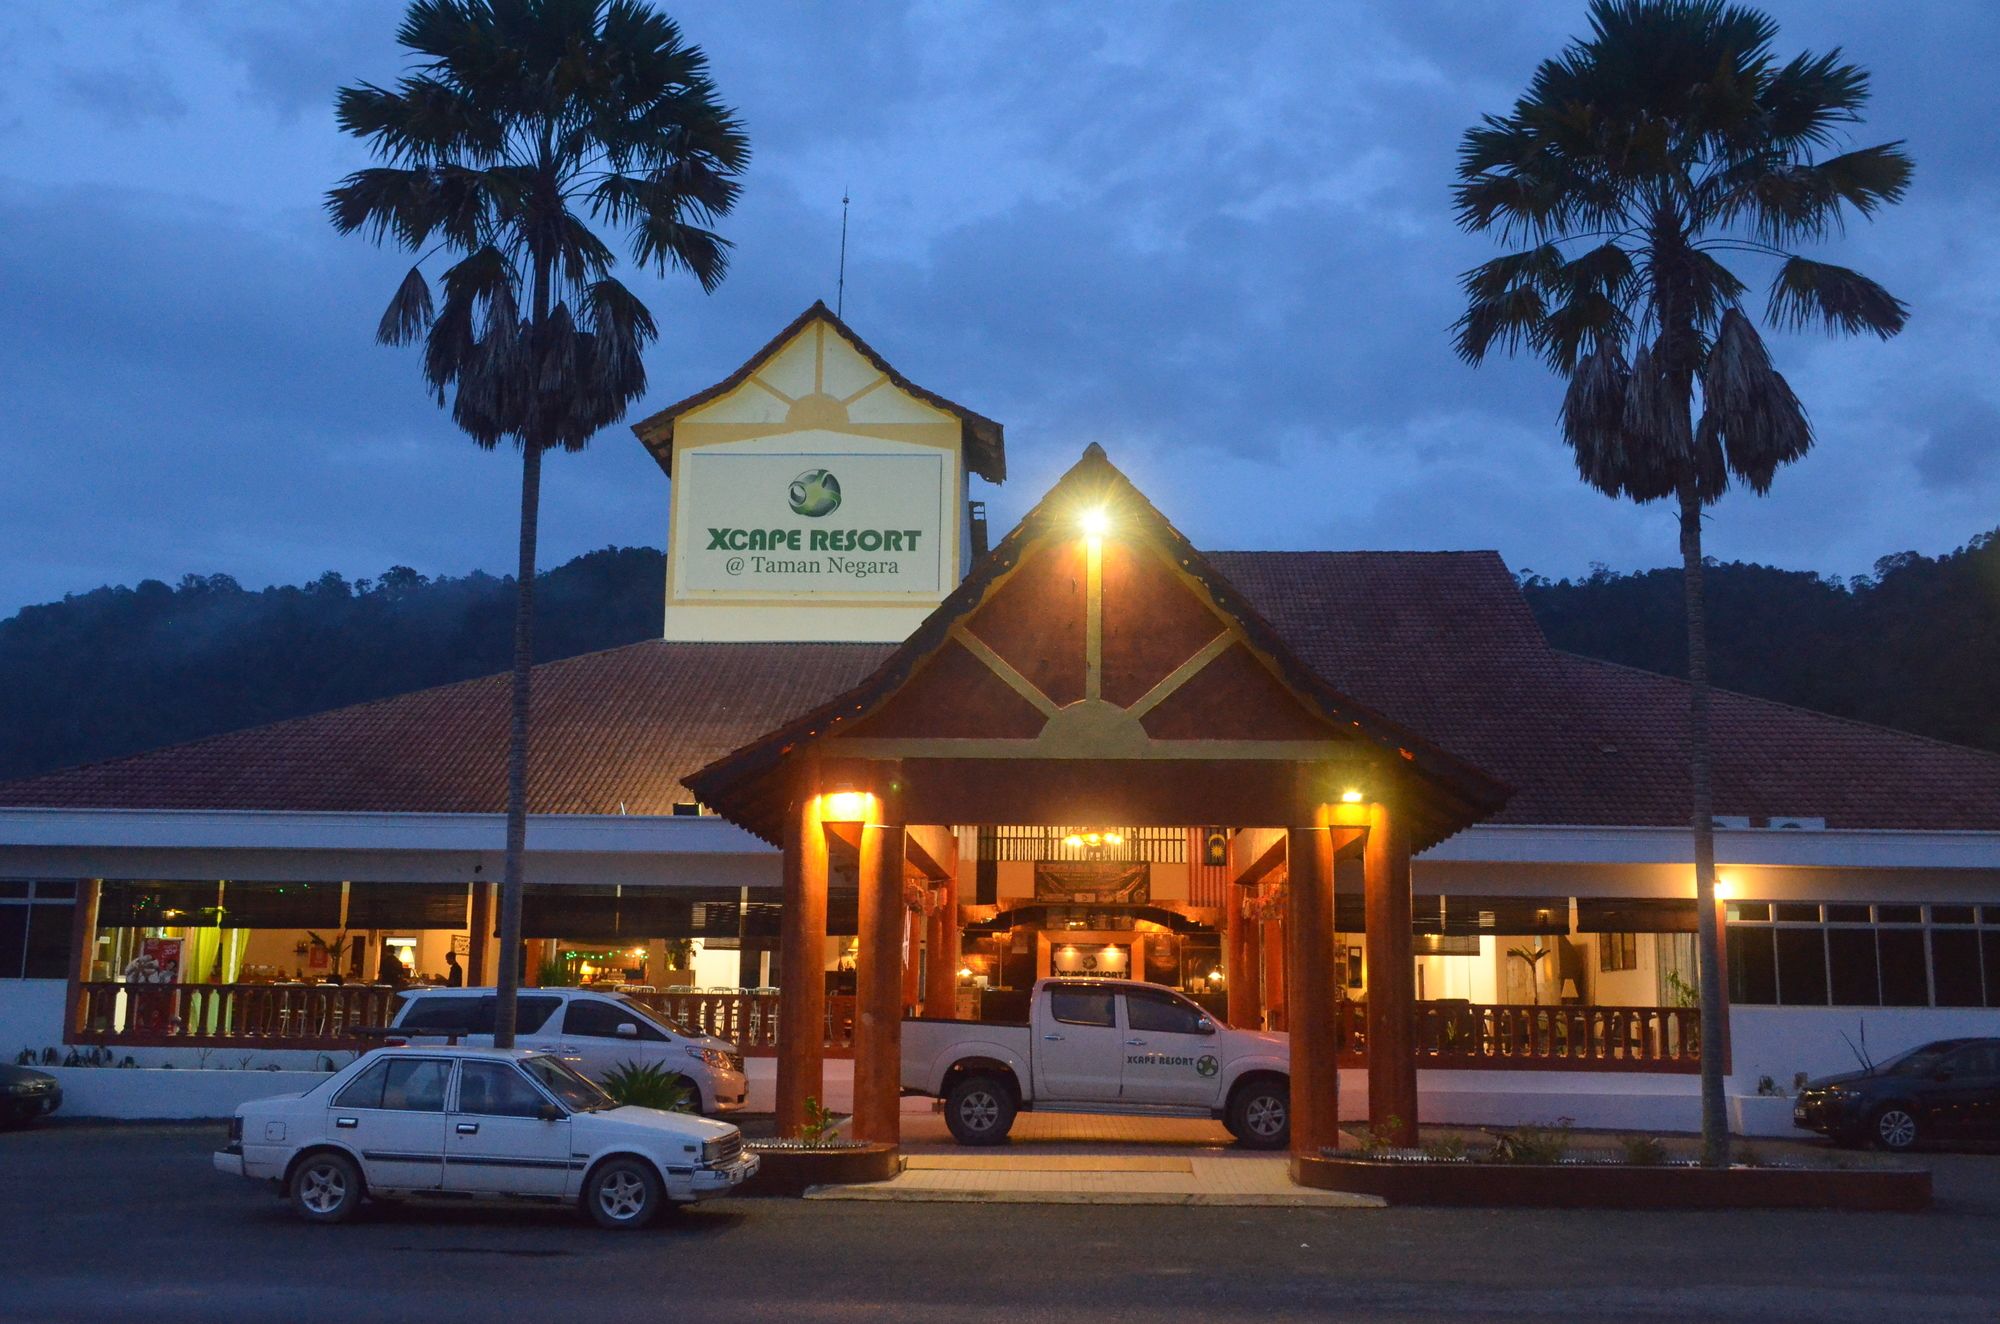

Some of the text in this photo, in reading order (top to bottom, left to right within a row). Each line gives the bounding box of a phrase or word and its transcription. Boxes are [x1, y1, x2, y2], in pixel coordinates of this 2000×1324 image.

[706, 528, 922, 552] XCAPE RESORT
[726, 556, 899, 578] @ Taman Negara
[1127, 1056, 1194, 1066] XCAPE RESORT
